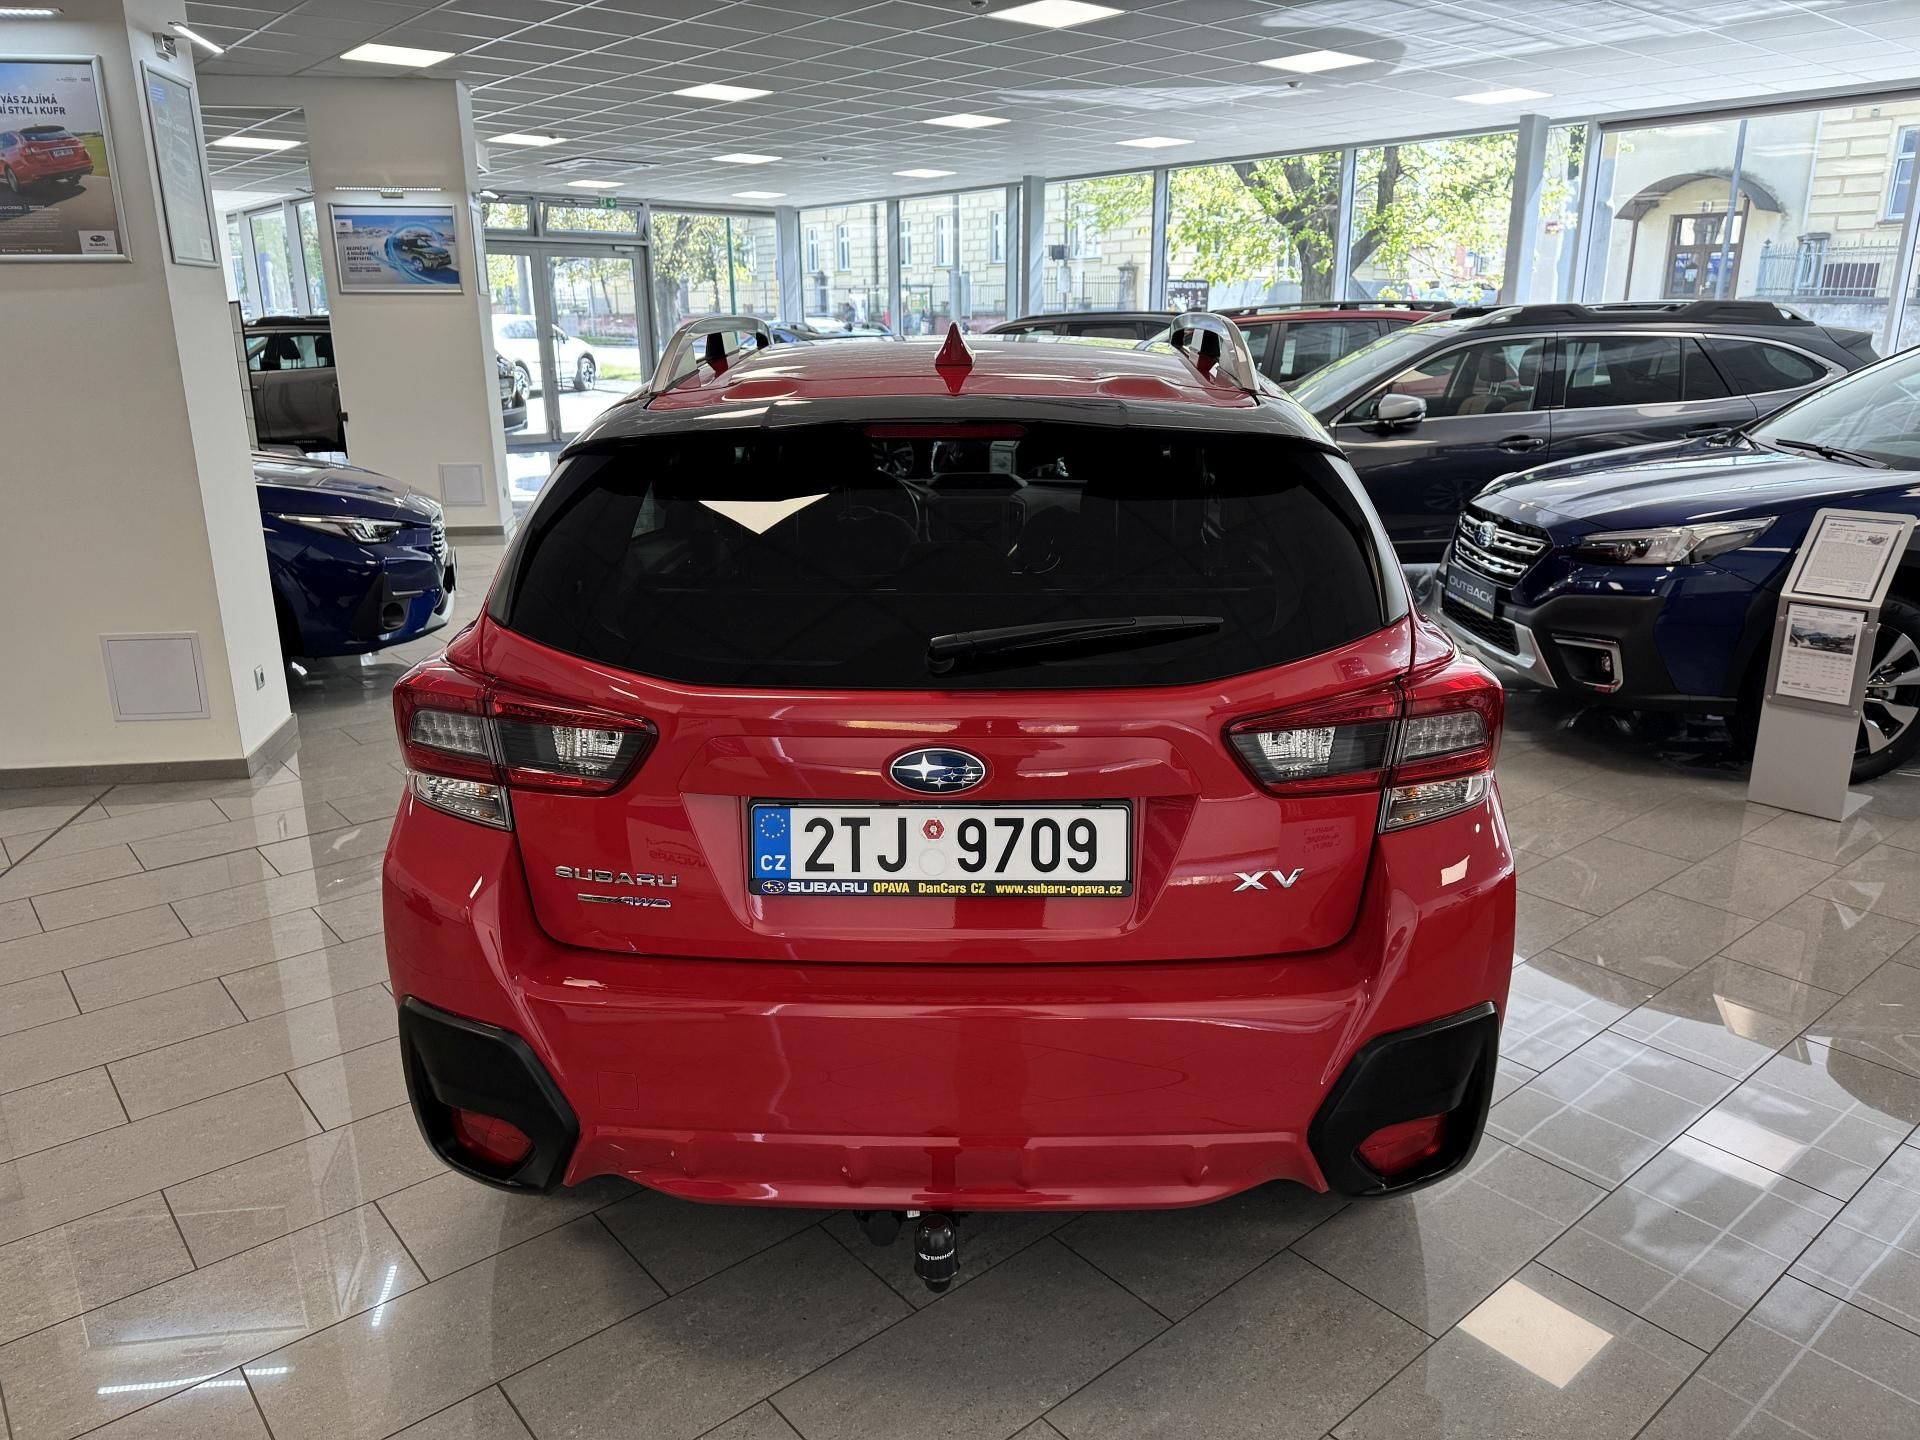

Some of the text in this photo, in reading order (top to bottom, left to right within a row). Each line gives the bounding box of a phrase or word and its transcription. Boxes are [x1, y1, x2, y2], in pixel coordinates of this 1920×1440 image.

[20, 93, 58, 104] ZAJÍMÁ
[8, 106, 33, 115] STYL
[39, 106, 66, 115] KUFR
[1449, 575, 1493, 605] OUTBACK
[804, 817, 1098, 873] 2TJ 9709
[760, 855, 786, 871] CZ
[554, 865, 678, 888] SUBARU
[1232, 867, 1305, 892] XV
[787, 881, 1123, 896] SUBARU OPAVA DanCars CZ www.subaru-opava.cz
